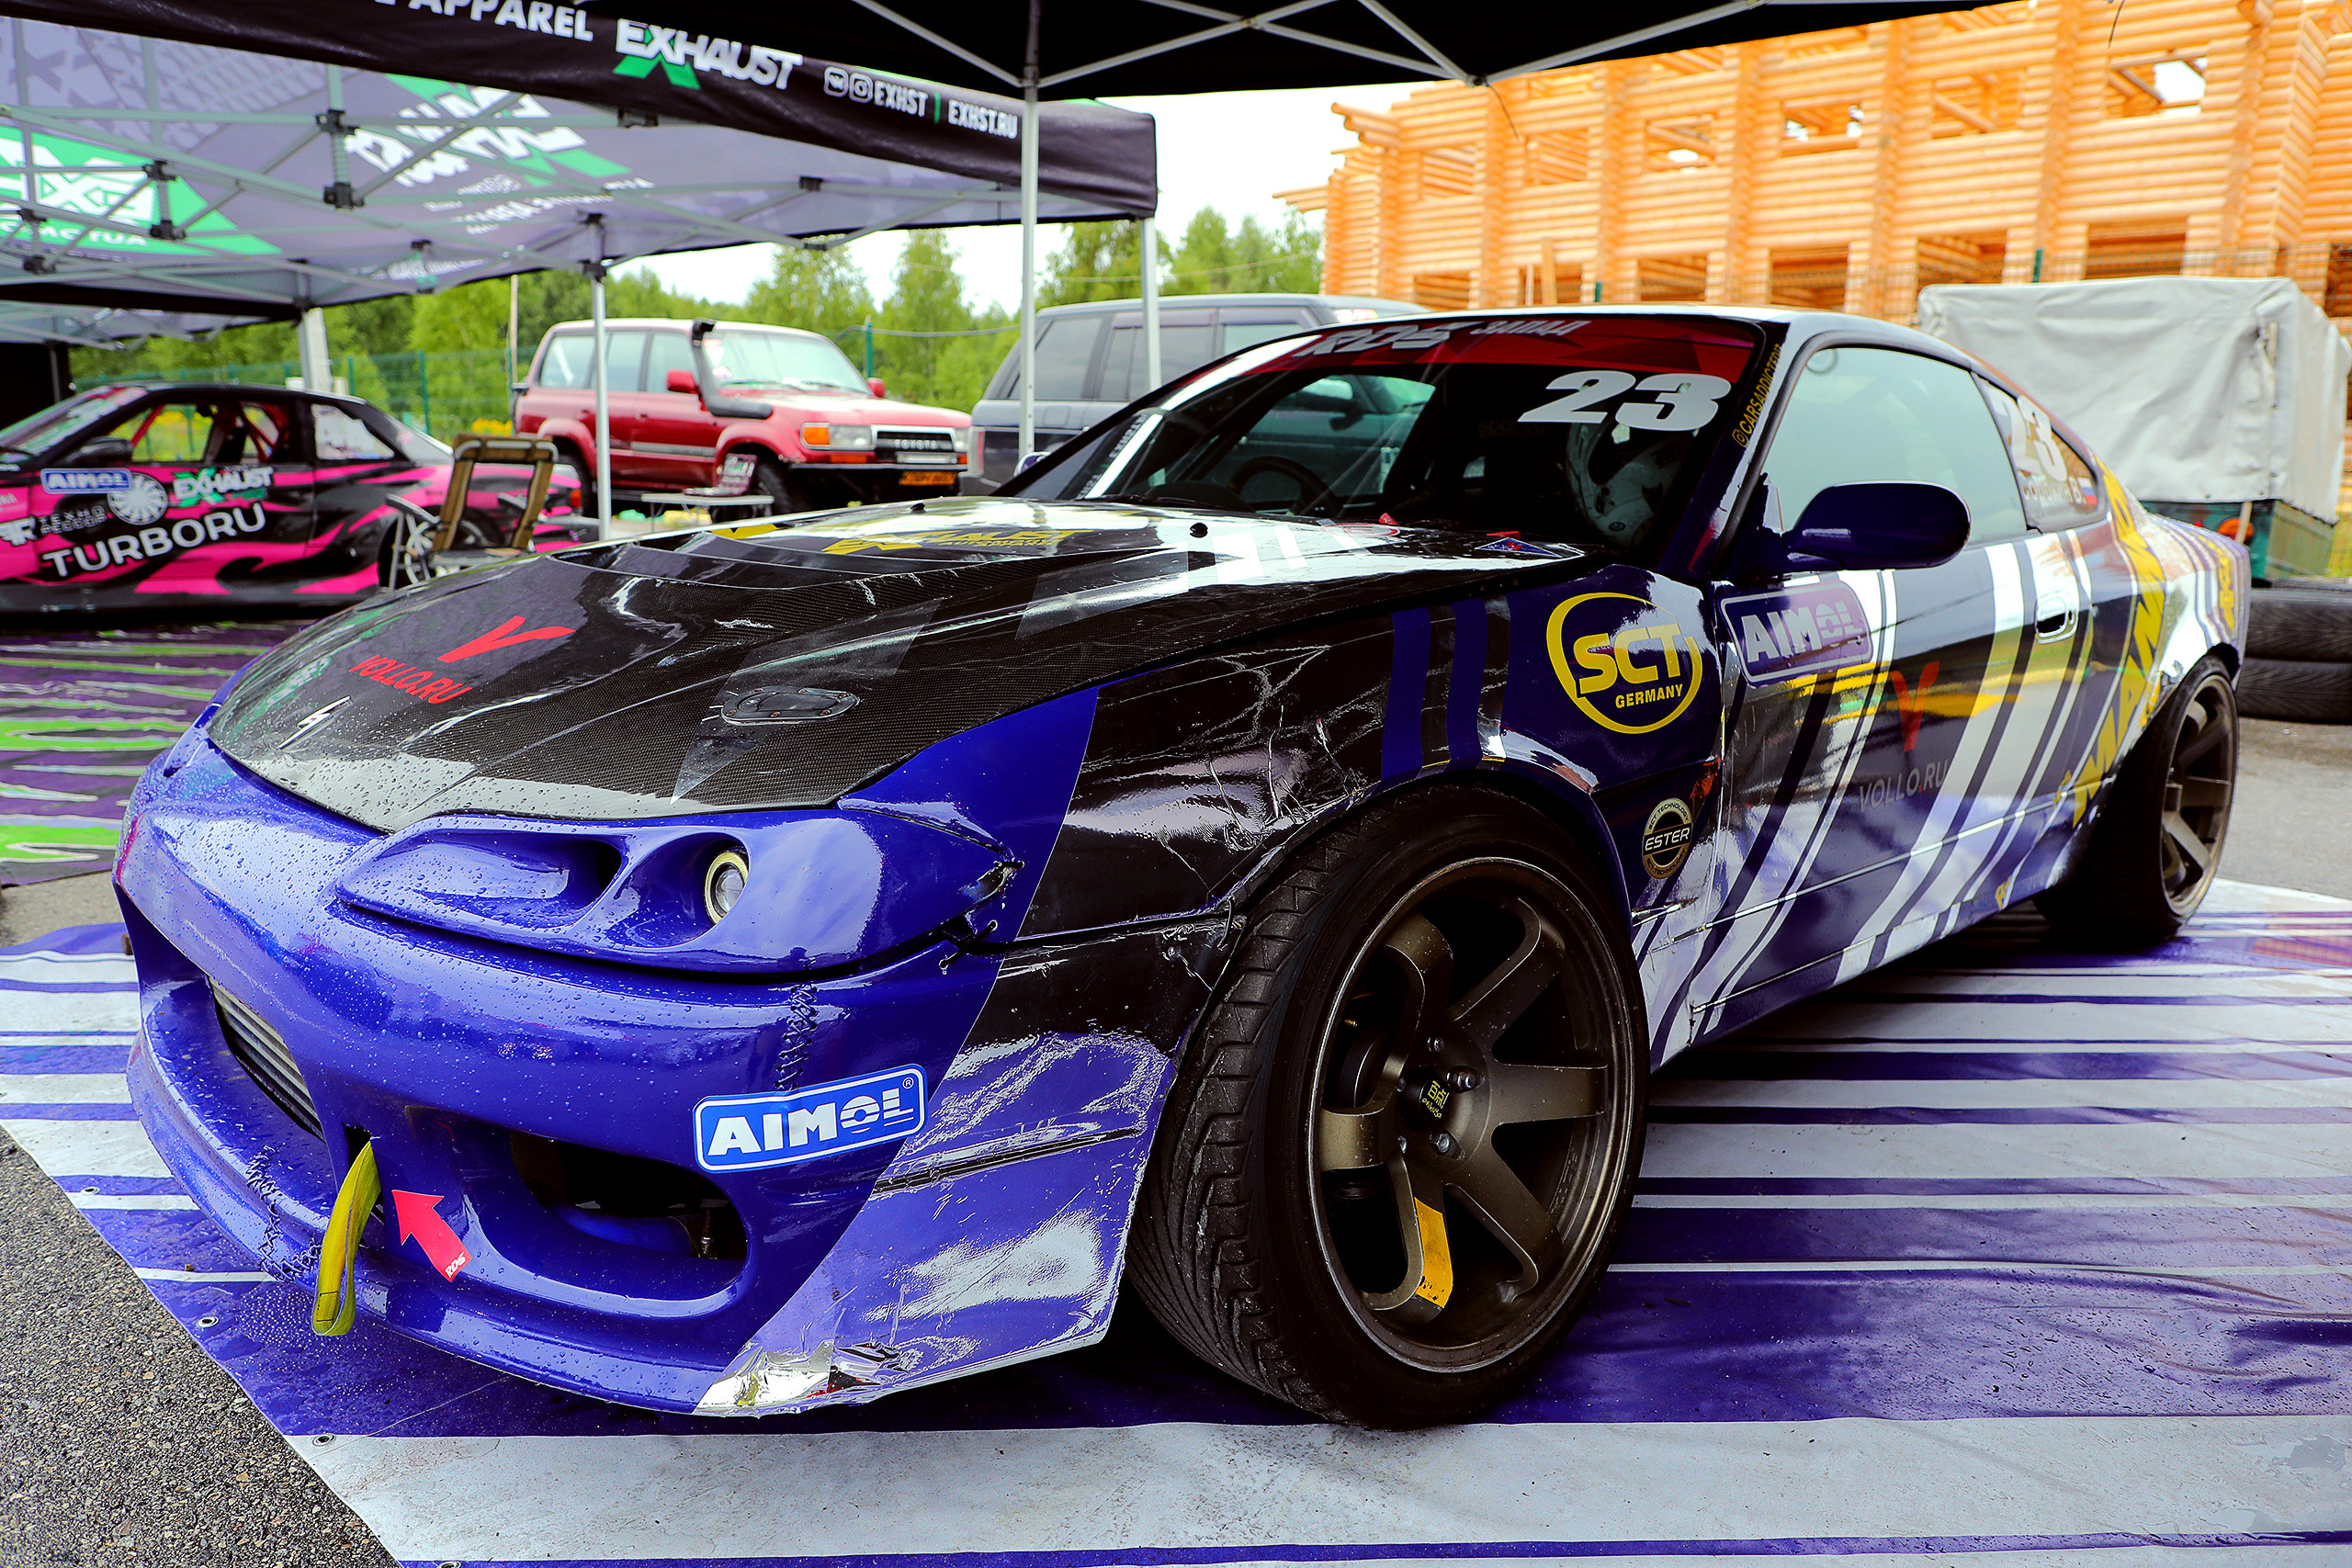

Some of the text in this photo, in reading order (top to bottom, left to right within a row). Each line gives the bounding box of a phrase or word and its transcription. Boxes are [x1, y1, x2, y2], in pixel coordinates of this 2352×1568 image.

[615, 18, 804, 90] EXHAUST
[874, 80, 1018, 139] EXHST EXHST.RU
[1518, 370, 1732, 431] 23
[1984, 384, 2069, 483] 23
[47, 472, 129, 489] AIMOL
[172, 467, 274, 505] EXHAUST
[42, 502, 266, 578] TURBORU
[1573, 623, 1685, 694] SCT
[1741, 604, 1865, 663] AIMOL
[348, 654, 473, 705] VOLLO.RU
[1615, 682, 1684, 709] GERMANY
[1859, 759, 1949, 813] VOLLO.RU
[1645, 827, 1690, 852] ESTER
[707, 1087, 915, 1156] AIMOL
[445, 1250, 466, 1278] RDS
